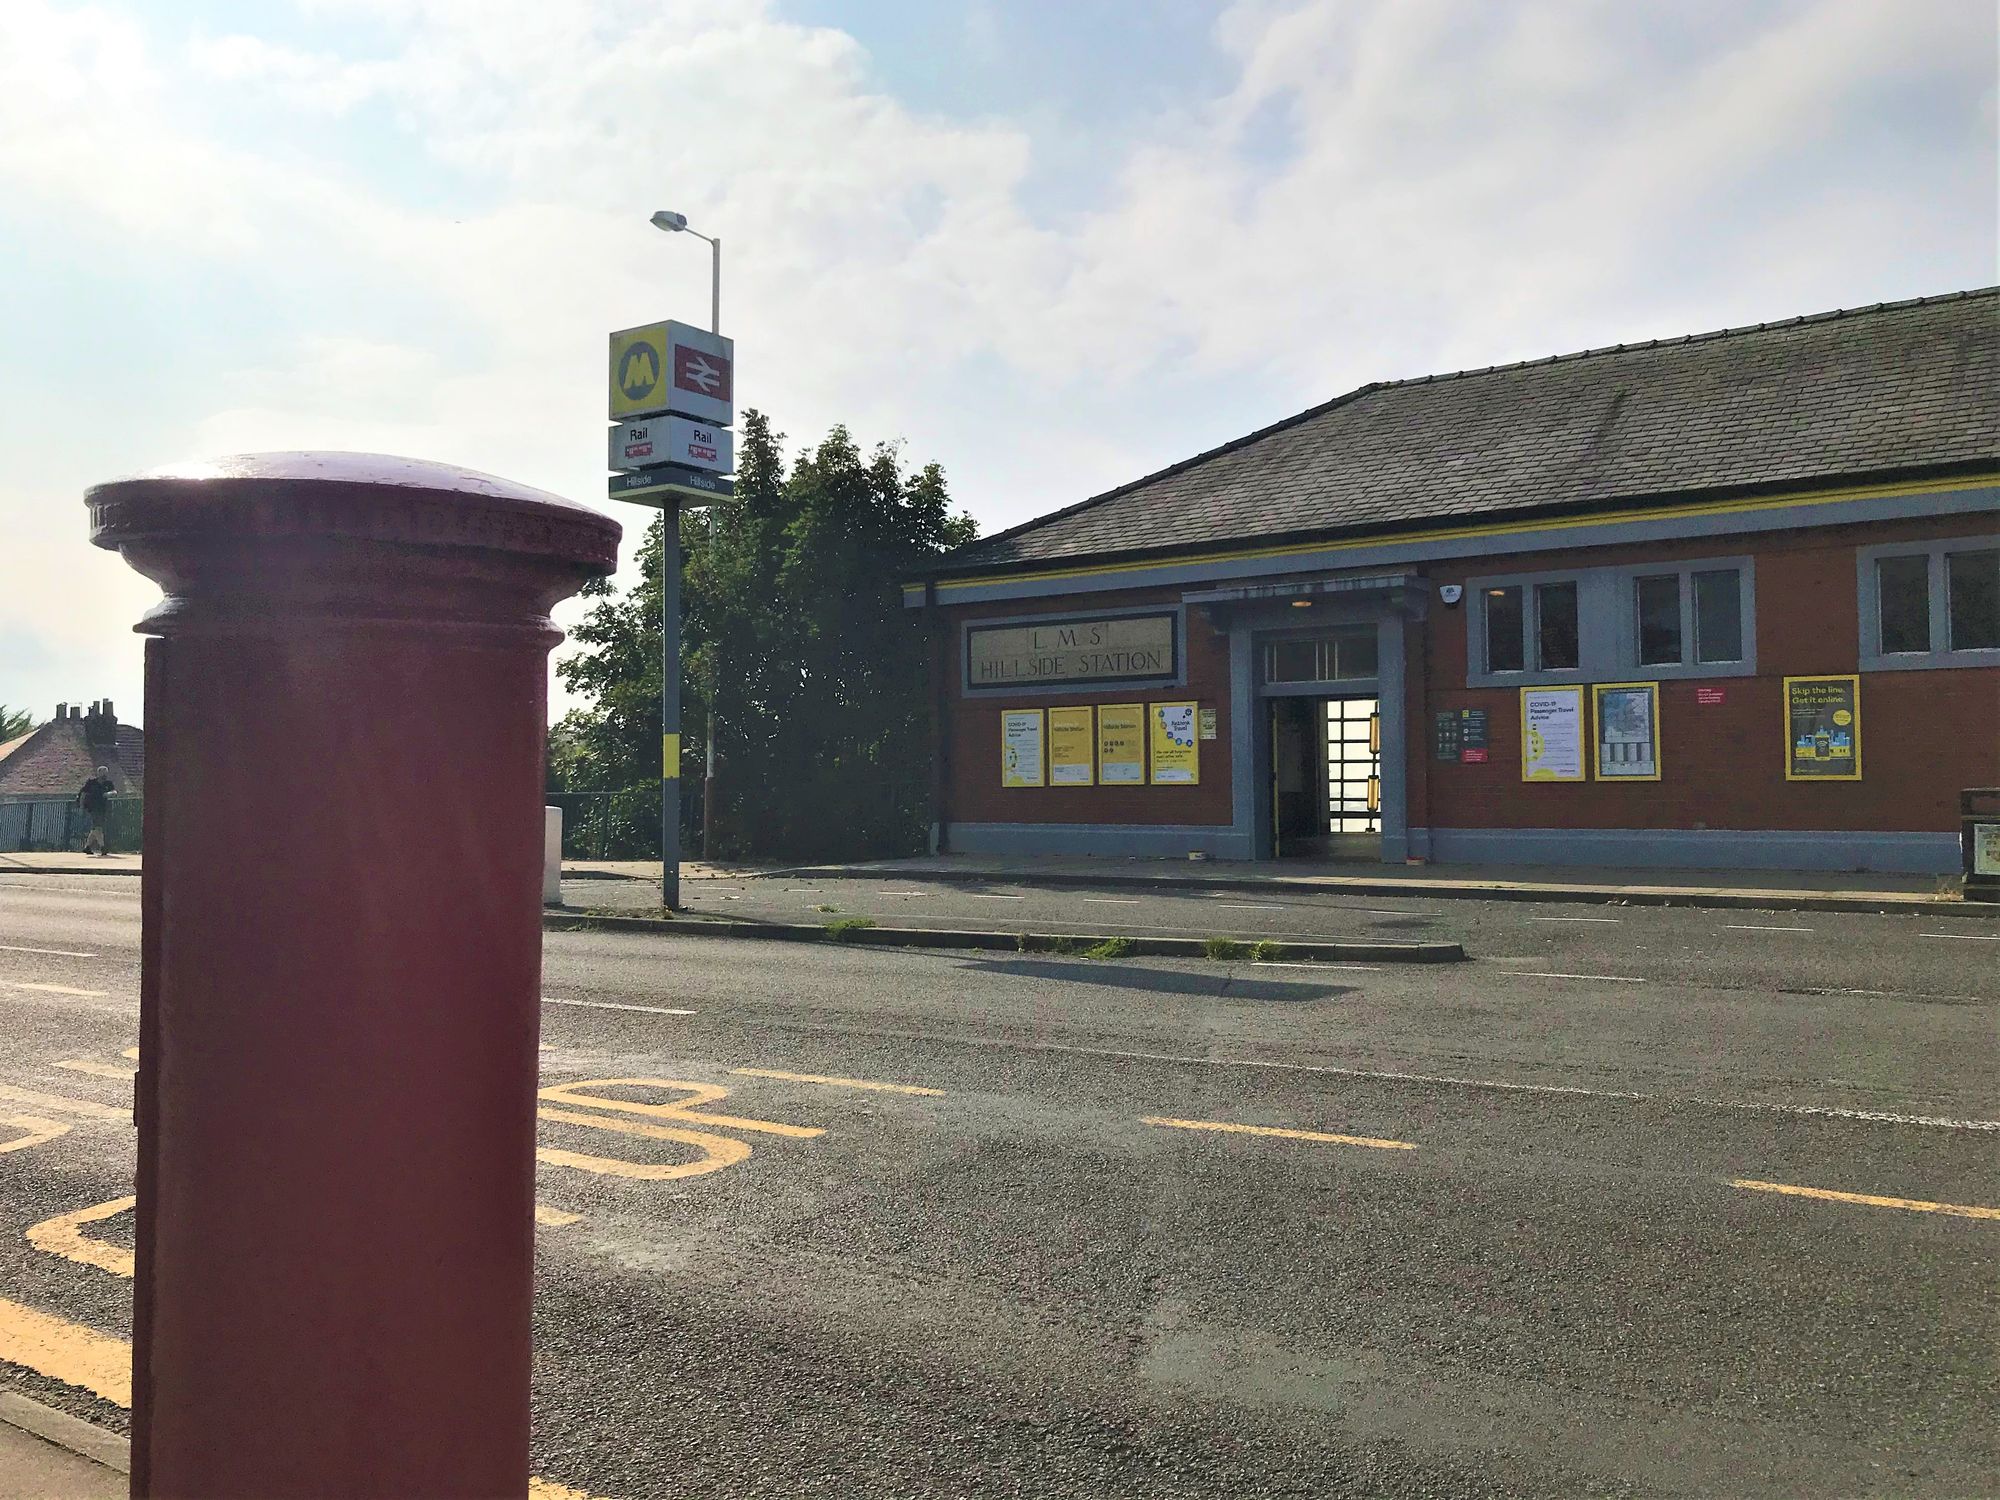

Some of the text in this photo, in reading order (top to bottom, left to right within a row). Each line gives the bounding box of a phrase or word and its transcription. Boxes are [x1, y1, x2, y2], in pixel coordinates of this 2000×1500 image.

[630, 427, 648, 441] Rail
[693, 429, 712, 444] Rail
[626, 474, 652, 487] Hillside
[689, 475, 716, 489] Hillside
[981, 656, 1065, 680] HILLSIDE
[1792, 687, 1810, 695] Skip
